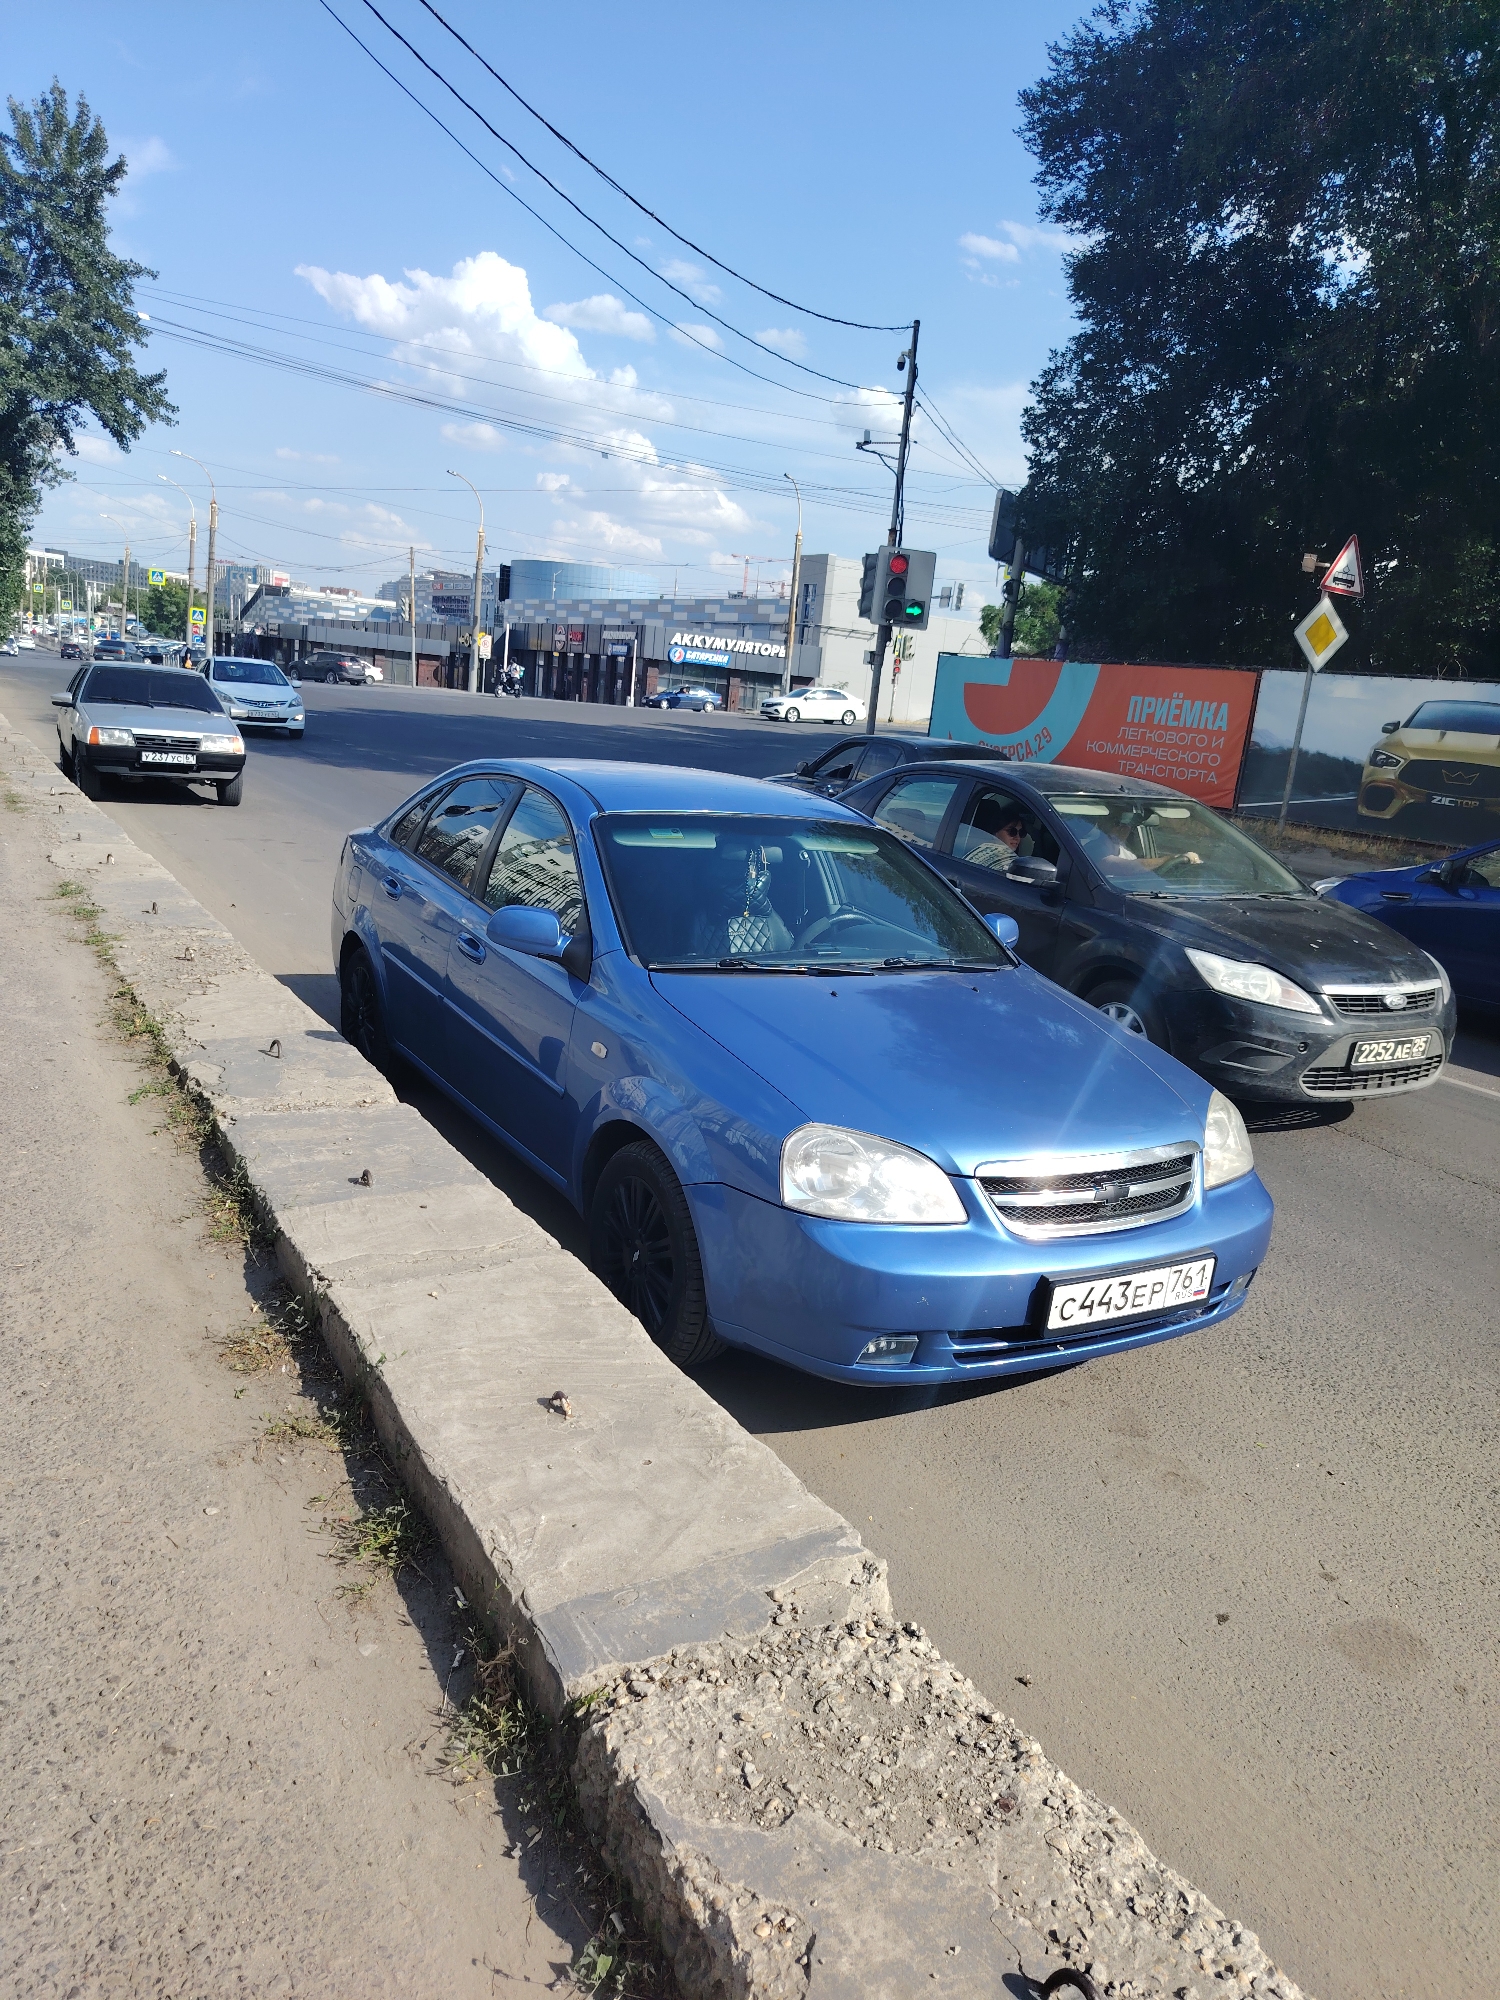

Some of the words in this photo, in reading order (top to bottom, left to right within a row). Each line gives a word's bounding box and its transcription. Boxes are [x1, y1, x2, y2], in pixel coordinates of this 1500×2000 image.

[1126, 692, 1229, 732] ПРИЁМКА
[1117, 726, 1208, 748] ЛЕГКОВОГО
[1211, 736, 1225, 749] И
[1086, 740, 1221, 767] КОММЕРЧЕСКОГО
[1118, 760, 1218, 785] ТРАНСПОРТА
[1171, 1264, 1208, 1293] 761
[1174, 1291, 1194, 1301] RUS
